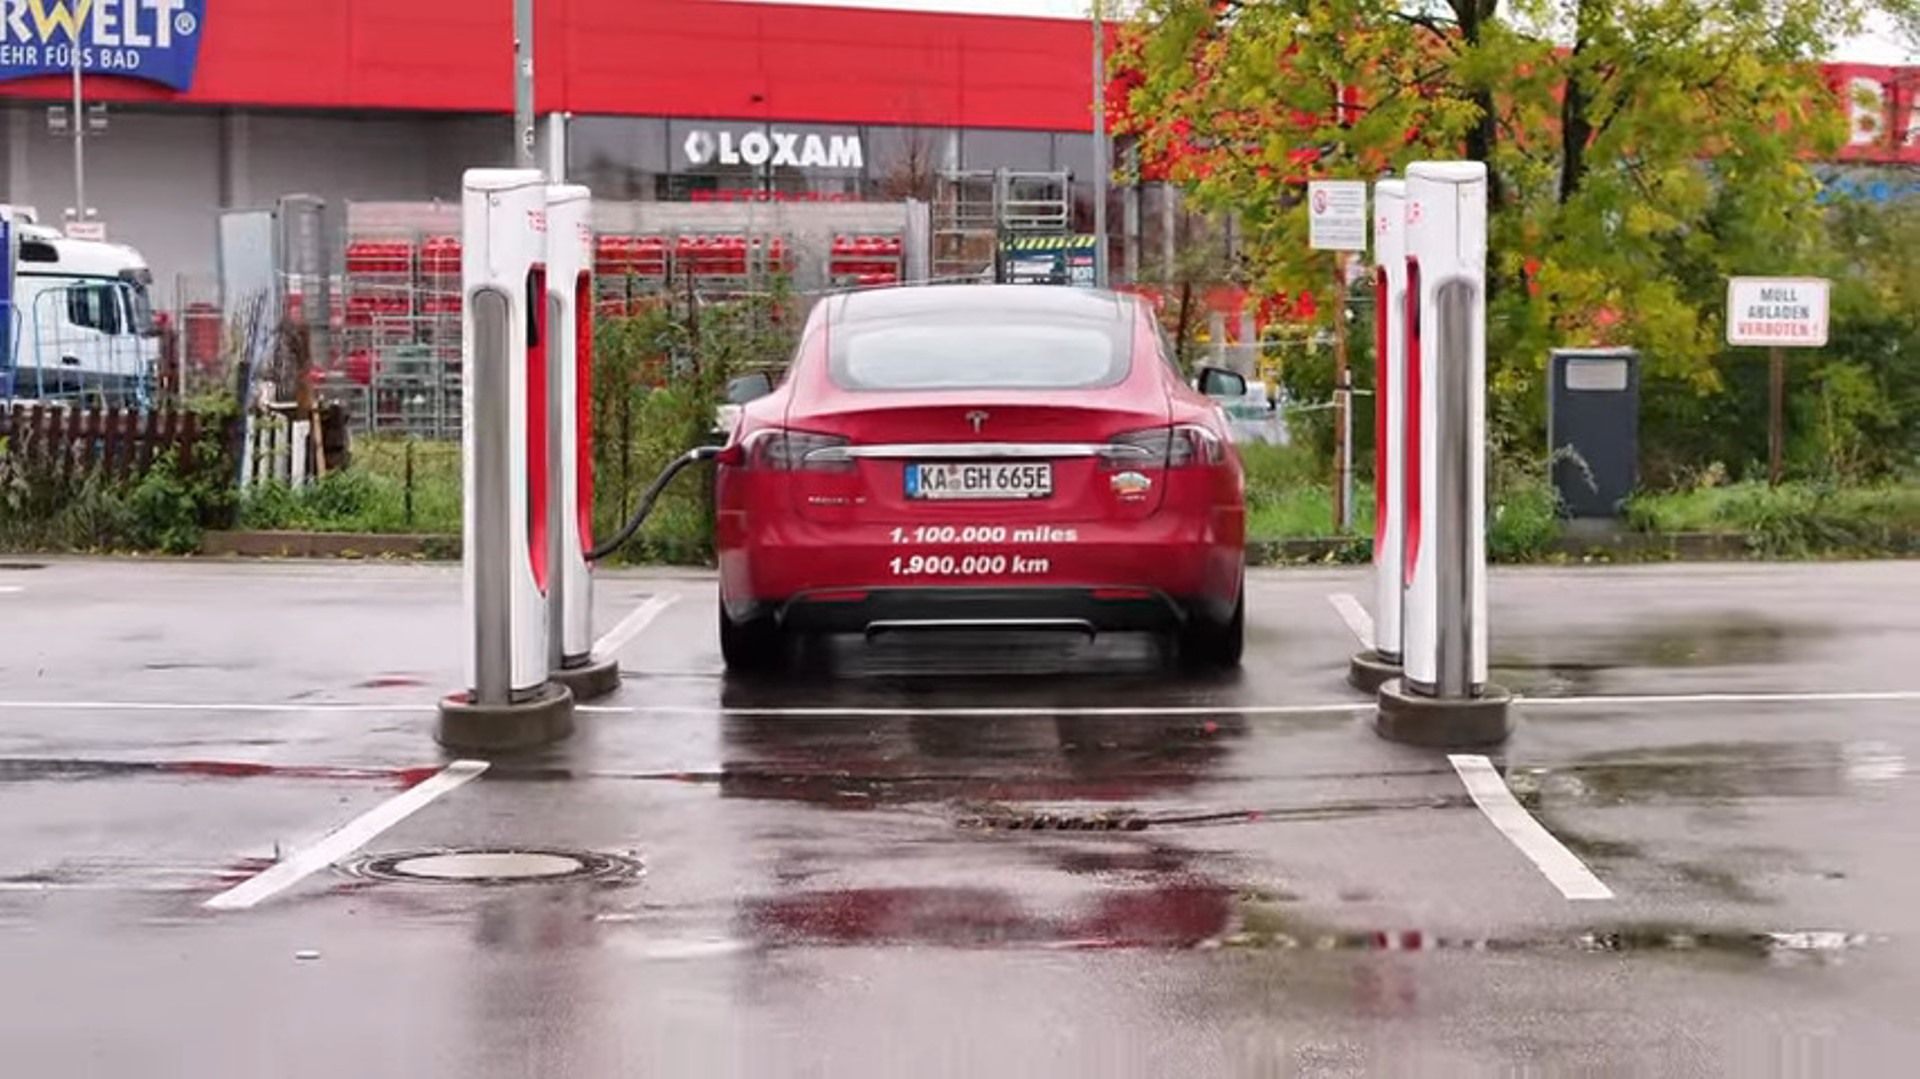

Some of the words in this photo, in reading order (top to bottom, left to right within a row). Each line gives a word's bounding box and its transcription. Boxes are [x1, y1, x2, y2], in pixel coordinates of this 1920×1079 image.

[100, 49, 140, 69] BAD
[719, 131, 863, 167] LOXAM
[1748, 305, 1809, 319] ABLADEN
[920, 466, 947, 490] KA
[963, 466, 991, 489] GH
[996, 465, 1048, 489] 665E
[1012, 525, 1078, 543] miles
[890, 555, 1006, 575] 1.900.000
[1011, 554, 1049, 574] km
